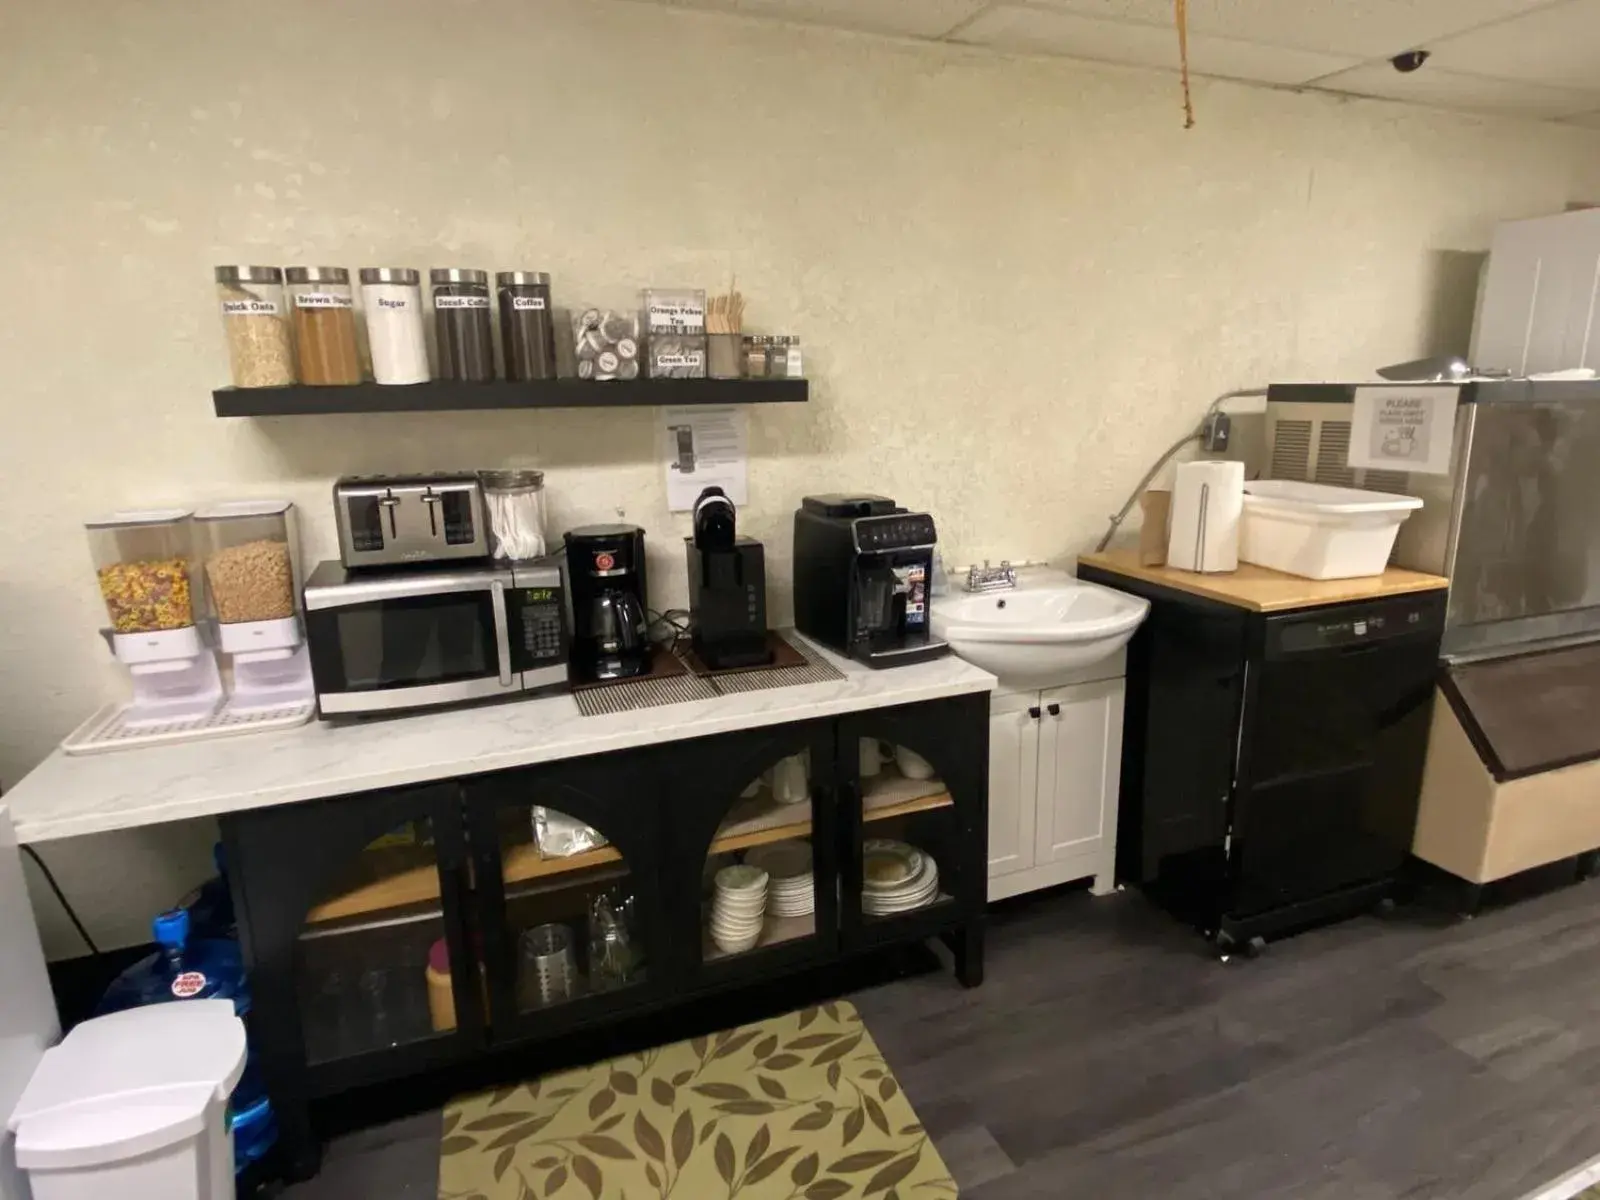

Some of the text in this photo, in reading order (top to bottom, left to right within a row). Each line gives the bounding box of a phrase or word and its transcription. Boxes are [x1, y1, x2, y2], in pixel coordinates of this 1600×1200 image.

[298, 295, 330, 304] Brown
[378, 298, 406, 308] Sugar
[515, 298, 542, 307] Coffee
[251, 303, 275, 311] Oats
